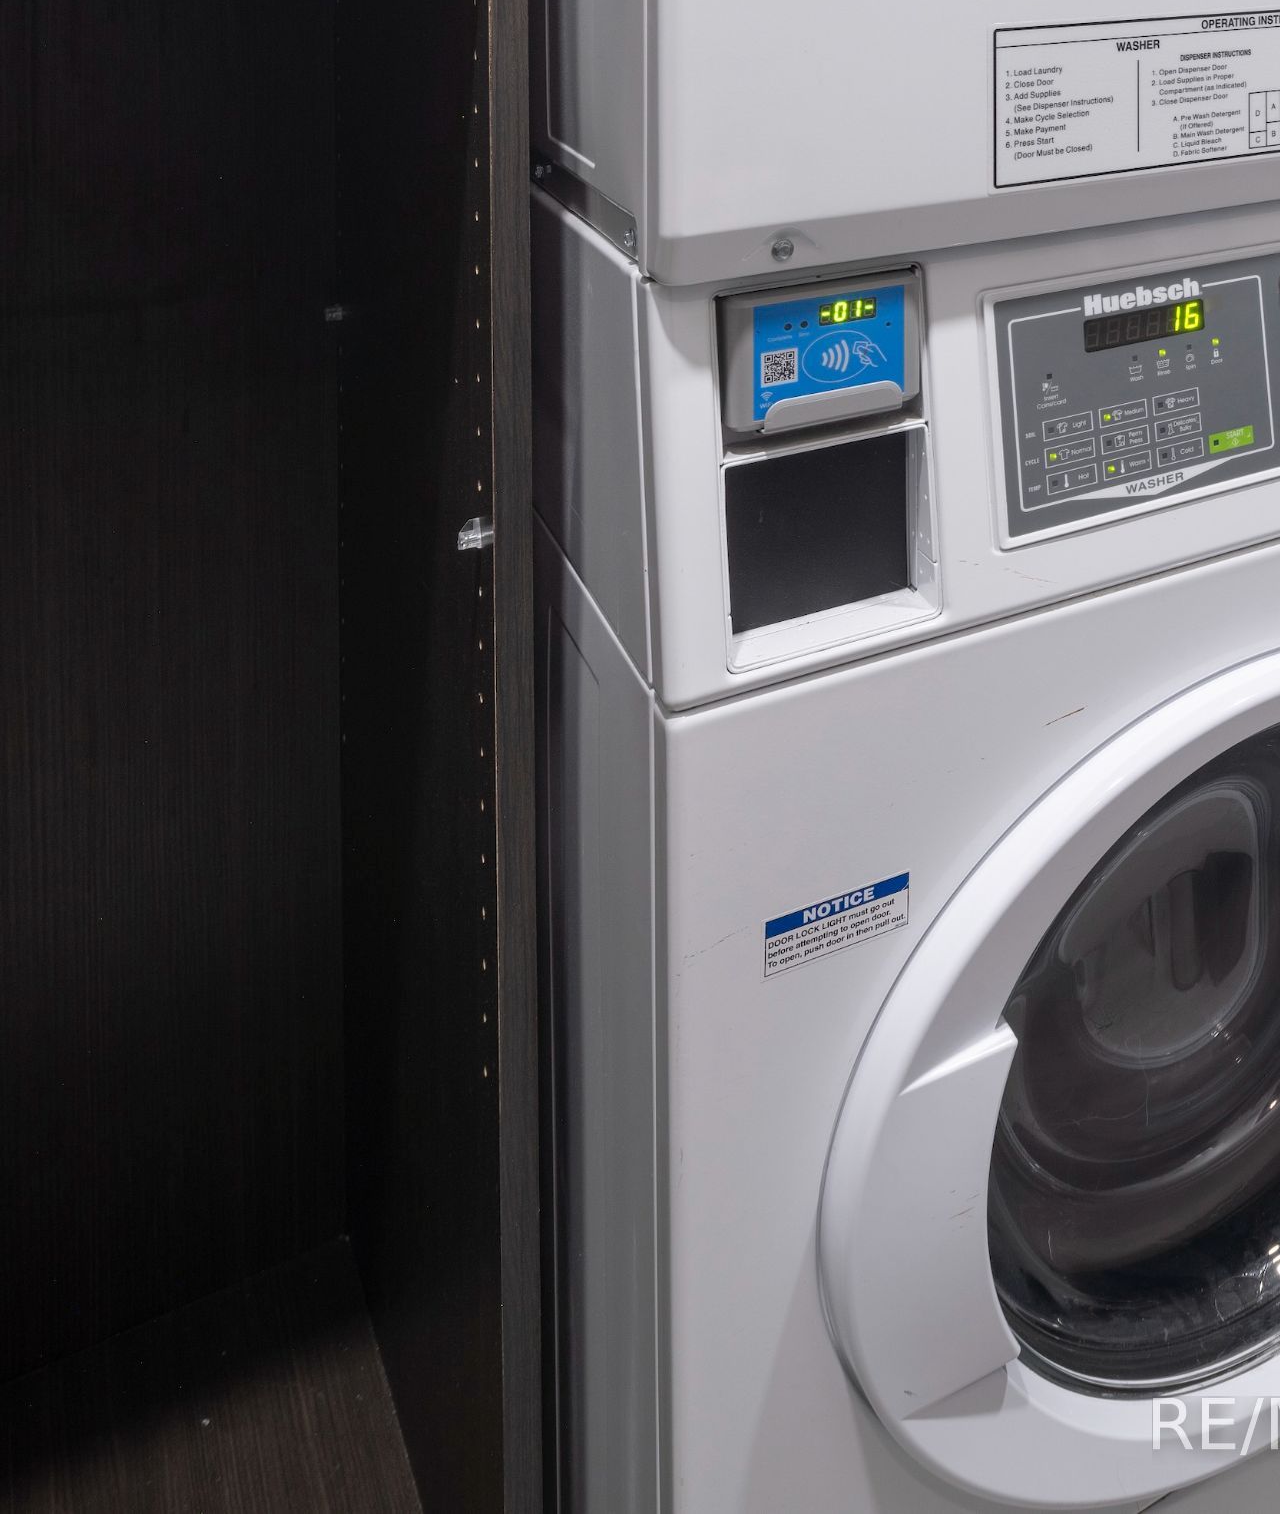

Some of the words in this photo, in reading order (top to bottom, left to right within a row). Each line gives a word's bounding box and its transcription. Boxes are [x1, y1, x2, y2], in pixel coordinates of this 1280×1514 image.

[1201, 16, 1255, 29] OPERATING
[1116, 39, 1160, 52] WASHER
[1180, 52, 1211, 61] DISPENSER
[1212, 49, 1251, 58] INSTRUCTIONS
[1014, 68, 1031, 76] Load
[1033, 66, 1062, 76] Laundry
[1005, 81, 1011, 89] 2.
[1014, 80, 1034, 88] Close
[1036, 78, 1053, 86] Door
[1005, 93, 1011, 101] 3.
[1014, 92, 1028, 100] Add
[1030, 89, 1061, 100] Supplies
[1014, 103, 1031, 113] (See
[1033, 99, 1068, 111] Dispenser
[1070, 95, 1113, 107] Instructions)
[1014, 115, 1033, 123] Make
[1035, 113, 1055, 123] Cycle
[1058, 109, 1089, 119] Selection
[1014, 126, 1033, 135] Make
[1036, 123, 1065, 135] Payment
[1083, 275, 1200, 317] Huebsch
[821, 300, 874, 322] -01-
[1173, 301, 1199, 331] 16
[1072, 418, 1086, 429] Light
[1123, 406, 1144, 416] Medium
[1177, 394, 1194, 405] Heavy
[1225, 428, 1244, 439] START
[1070, 444, 1092, 455] Normal
[1077, 471, 1089, 480] Hot
[1129, 458, 1146, 467] Warm
[1180, 445, 1194, 455] Cold
[1125, 471, 1184, 494] WASHER
[803, 886, 874, 923] NOTICE
[768, 934, 793, 949] DOOR
[796, 924, 819, 939] LOCK
[822, 915, 846, 929] LIGHT
[849, 907, 867, 920] must
[870, 904, 879, 913] go
[882, 898, 894, 908] out
[767, 944, 793, 959] before
[795, 927, 838, 950] attempting
[840, 924, 848, 932] to
[850, 917, 869, 930] open
[871, 908, 890, 921] door.
[768, 959, 777, 968] To
[779, 951, 802, 965] open,
[804, 943, 823, 956] push
[826, 934, 844, 947] door
[846, 931, 853, 939] in
[856, 924, 872, 936] then
[875, 918, 889, 930] pull
[891, 912, 905, 923] out.
